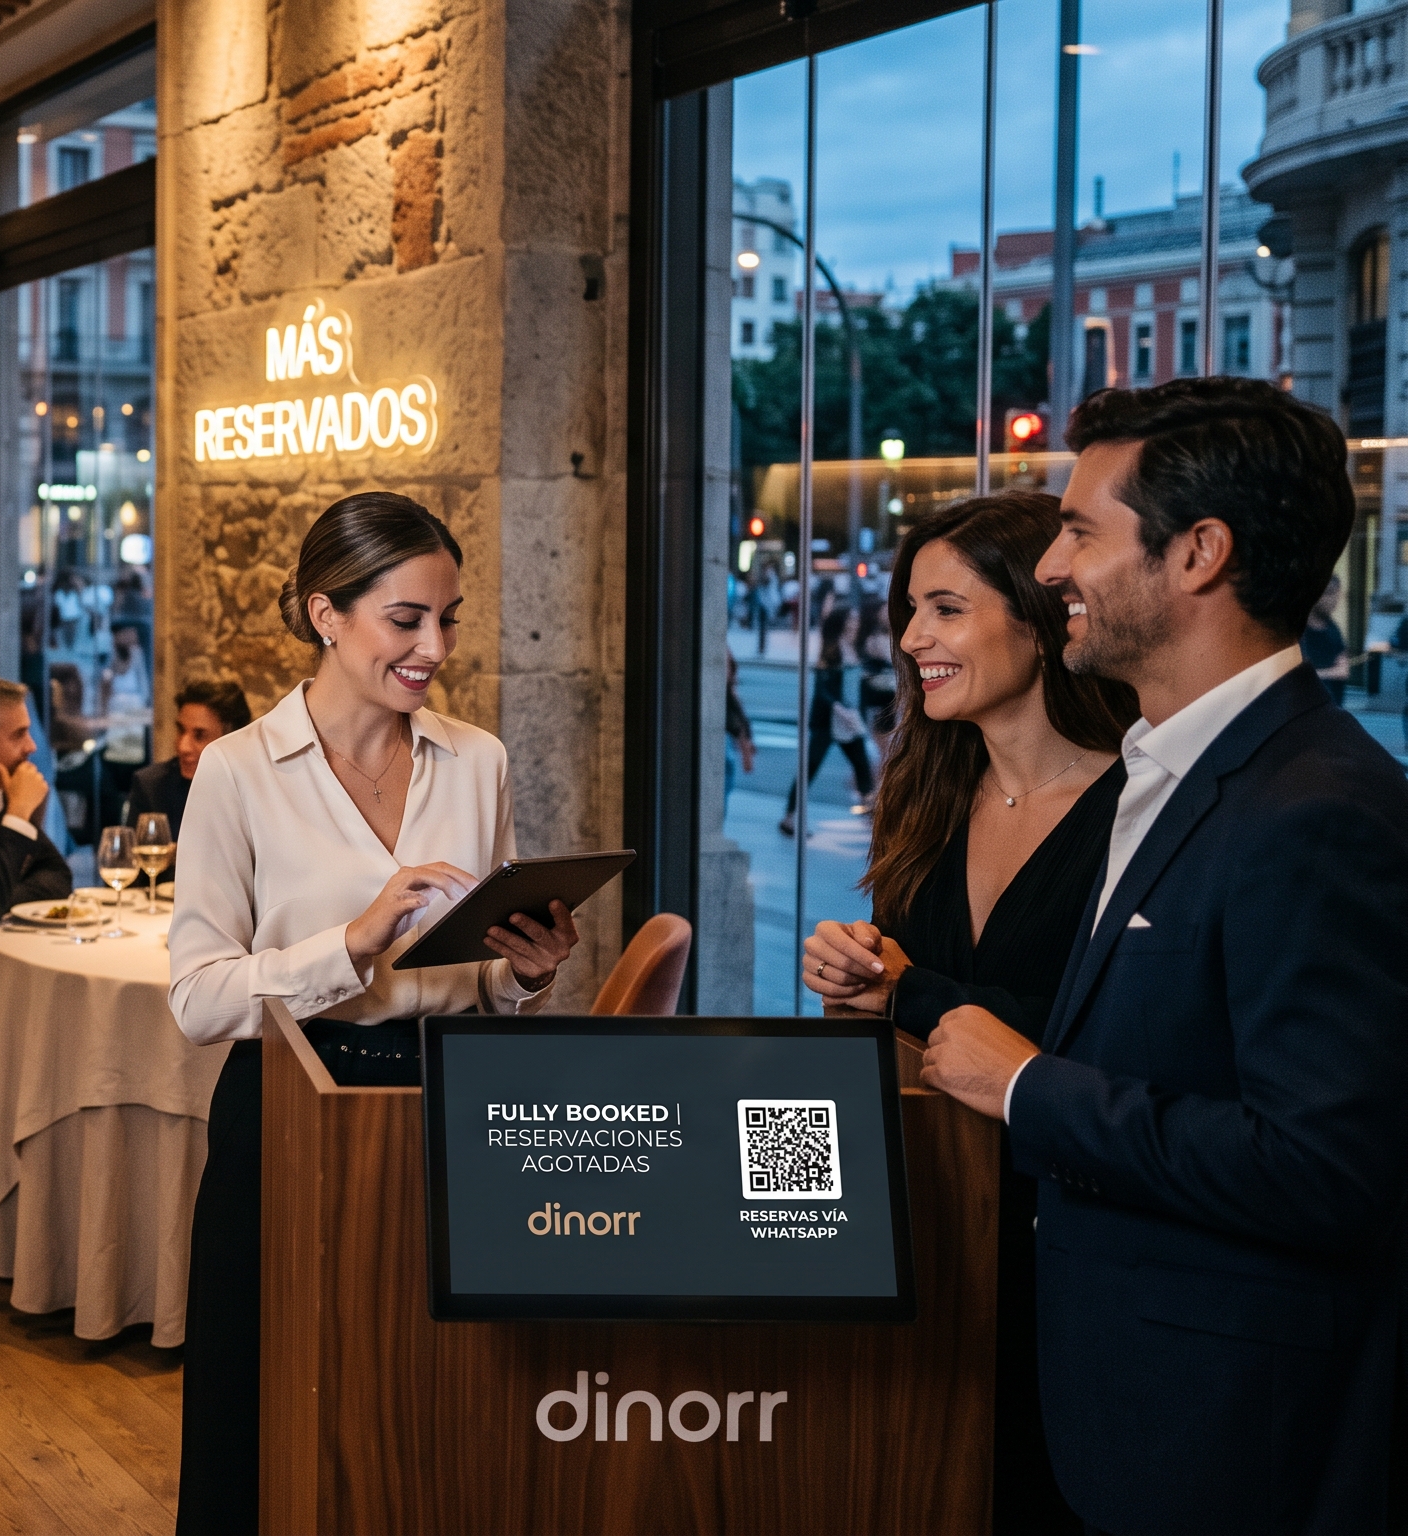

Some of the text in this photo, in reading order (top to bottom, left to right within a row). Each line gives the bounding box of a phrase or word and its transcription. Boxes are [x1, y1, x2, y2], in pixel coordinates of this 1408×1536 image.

[266, 304, 343, 382] MÁS
[195, 383, 428, 462] RESERVADOS
[487, 1103, 559, 1122] FULLY
[566, 1104, 669, 1122] BOOKED
[488, 1129, 683, 1148] RESERVACIONES
[521, 1154, 651, 1173] AGOTADAS
[527, 1202, 641, 1236] dinorr
[739, 1207, 849, 1222] RESERVAS VÍA
[750, 1226, 838, 1239] WHATSAPP
[535, 1370, 788, 1443] dinorr
